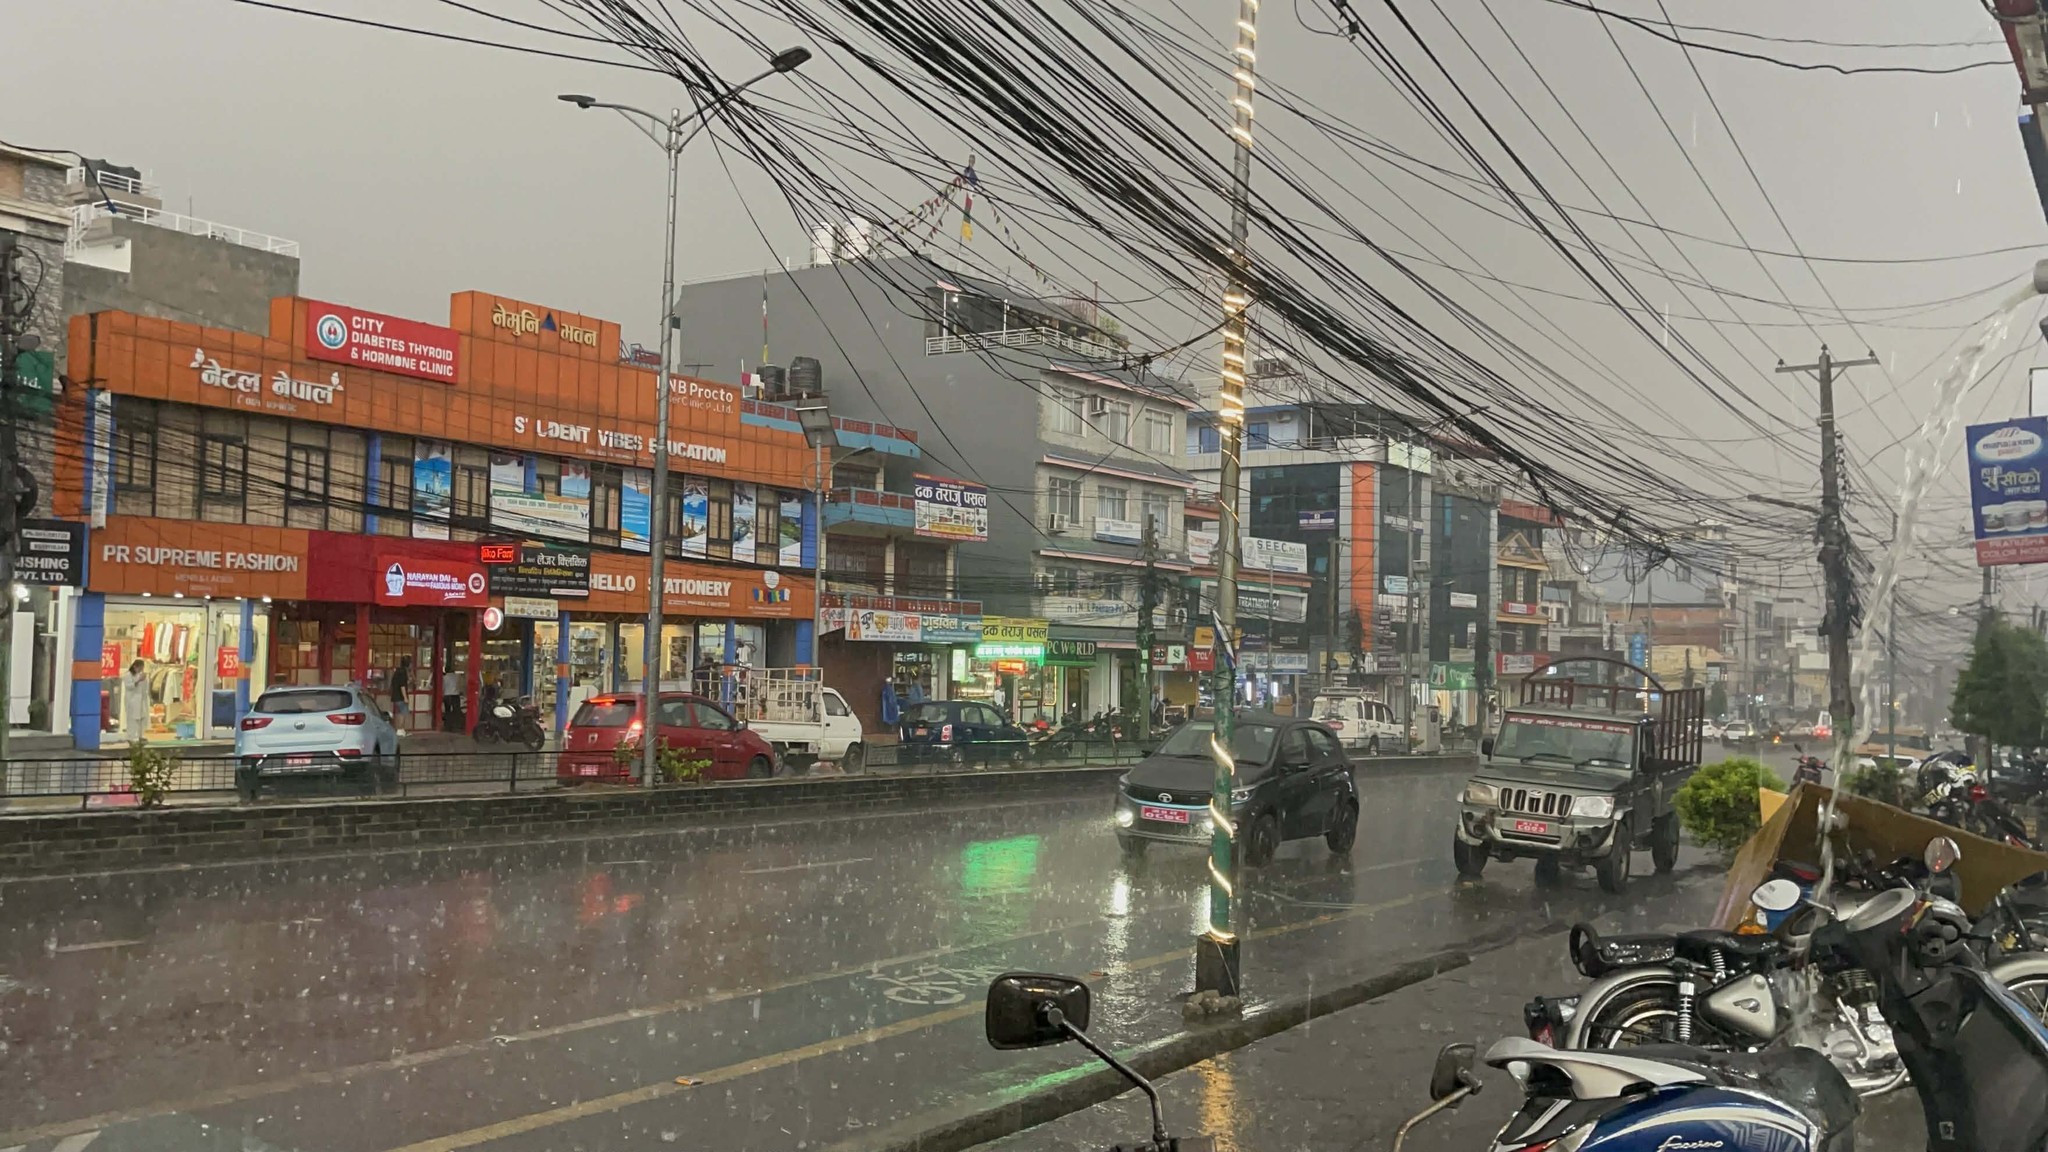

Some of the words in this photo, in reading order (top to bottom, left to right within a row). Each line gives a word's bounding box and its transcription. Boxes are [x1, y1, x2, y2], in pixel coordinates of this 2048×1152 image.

[352, 316, 384, 333] CITY
[560, 323, 598, 347] भवन
[351, 331, 405, 353] DIABETES
[408, 342, 453, 361] THYROID
[351, 347, 359, 359] &
[362, 349, 416, 370] HORMONE
[420, 360, 453, 376] CLINIC
[272, 370, 335, 405] नेपाल
[690, 382, 734, 403] Procto
[514, 416, 591, 444] SUDENT
[598, 429, 643, 452] VIBES
[648, 437, 726, 464] EUCATION
[963, 491, 987, 507] पसल
[103, 545, 130, 564] PR
[135, 545, 222, 569] SUPREME
[226, 551, 298, 572] FASHION
[42, 571, 68, 582] LTD.
[589, 573, 636, 592] HELLO
[647, 576, 732, 597] ATIONERY
[1047, 641, 1059, 655] PC
[1195, 651, 1208, 661] TCL
